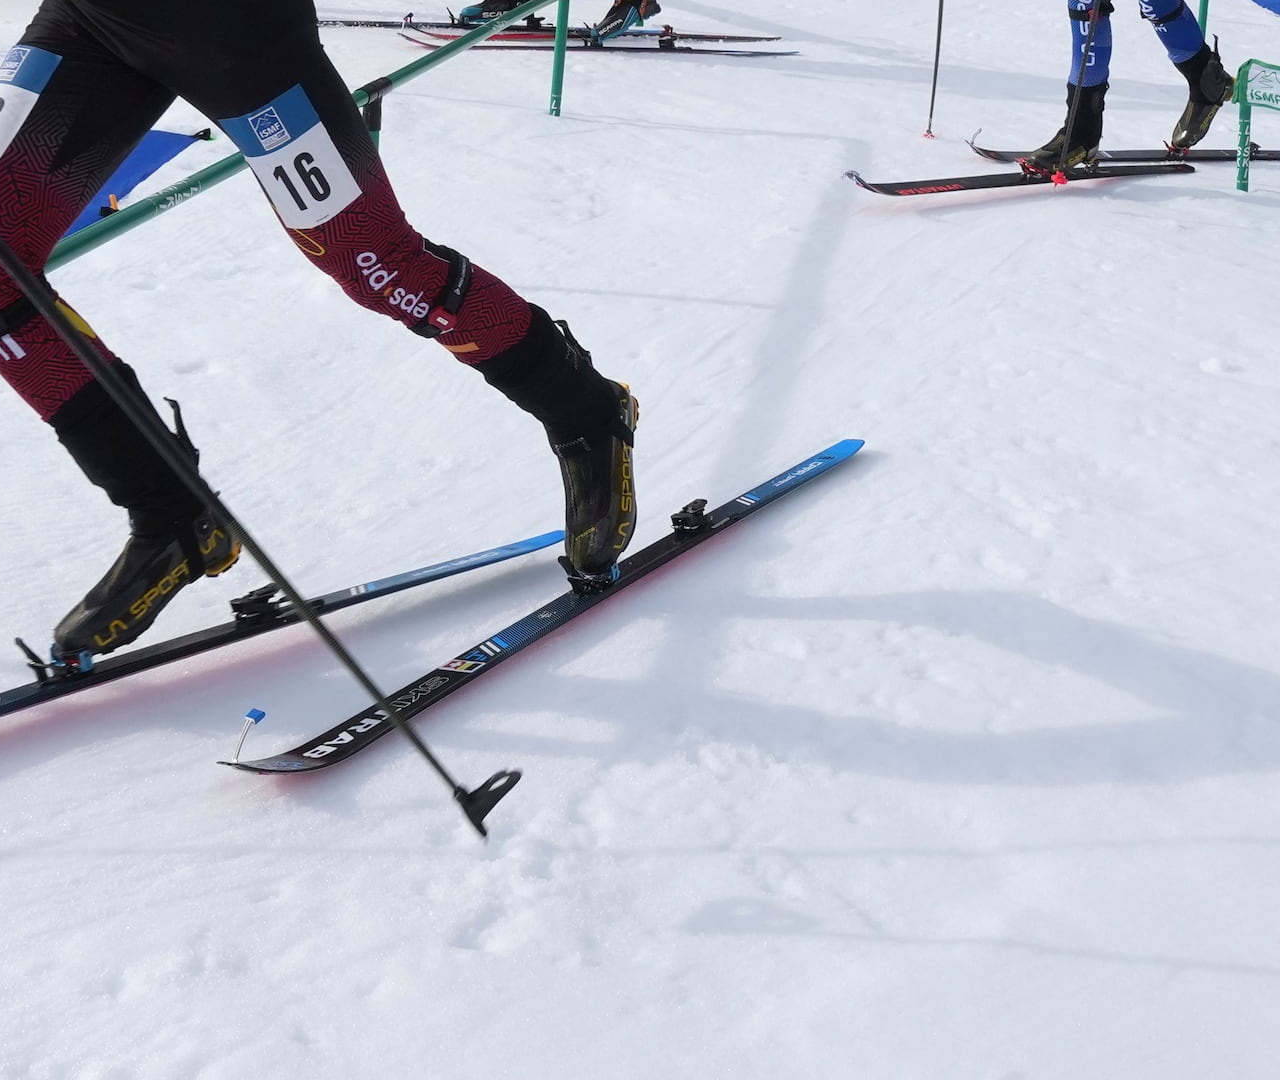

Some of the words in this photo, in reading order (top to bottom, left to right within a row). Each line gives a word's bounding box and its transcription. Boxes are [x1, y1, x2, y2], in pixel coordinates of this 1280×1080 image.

[259, 121, 282, 140] ISMF
[273, 152, 331, 211] 16
[613, 521, 630, 550] LA
[93, 619, 128, 646] LA
